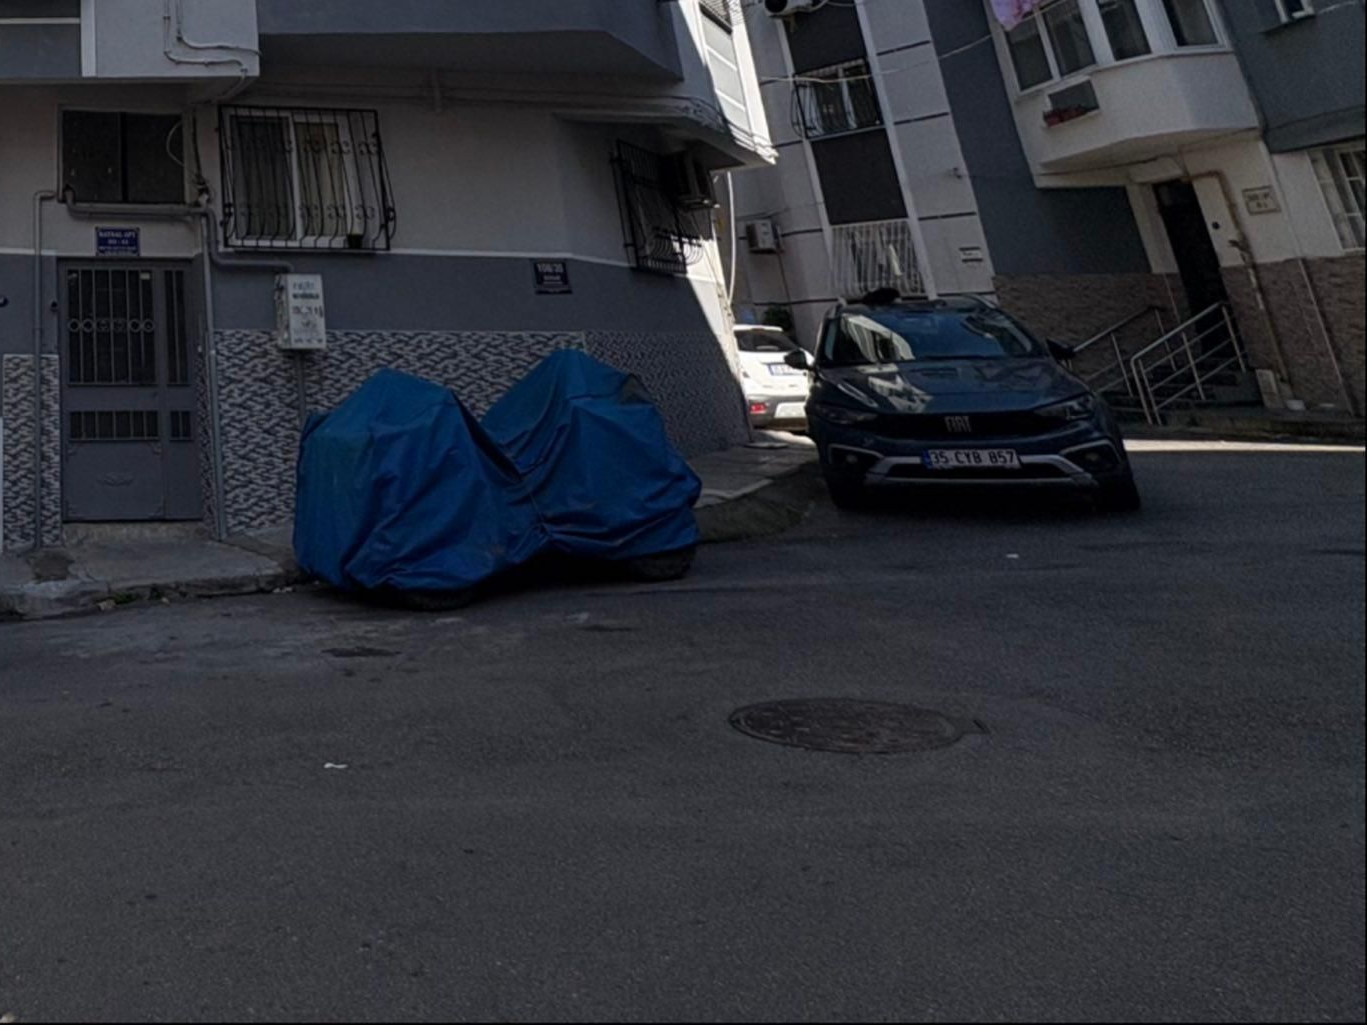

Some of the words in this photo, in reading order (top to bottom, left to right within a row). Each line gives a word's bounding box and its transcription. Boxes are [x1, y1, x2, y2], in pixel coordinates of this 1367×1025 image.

[944, 416, 972, 432] FIAT
[931, 451, 950, 465] 35
[954, 451, 983, 465] CYB
[987, 450, 1014, 464] 857
